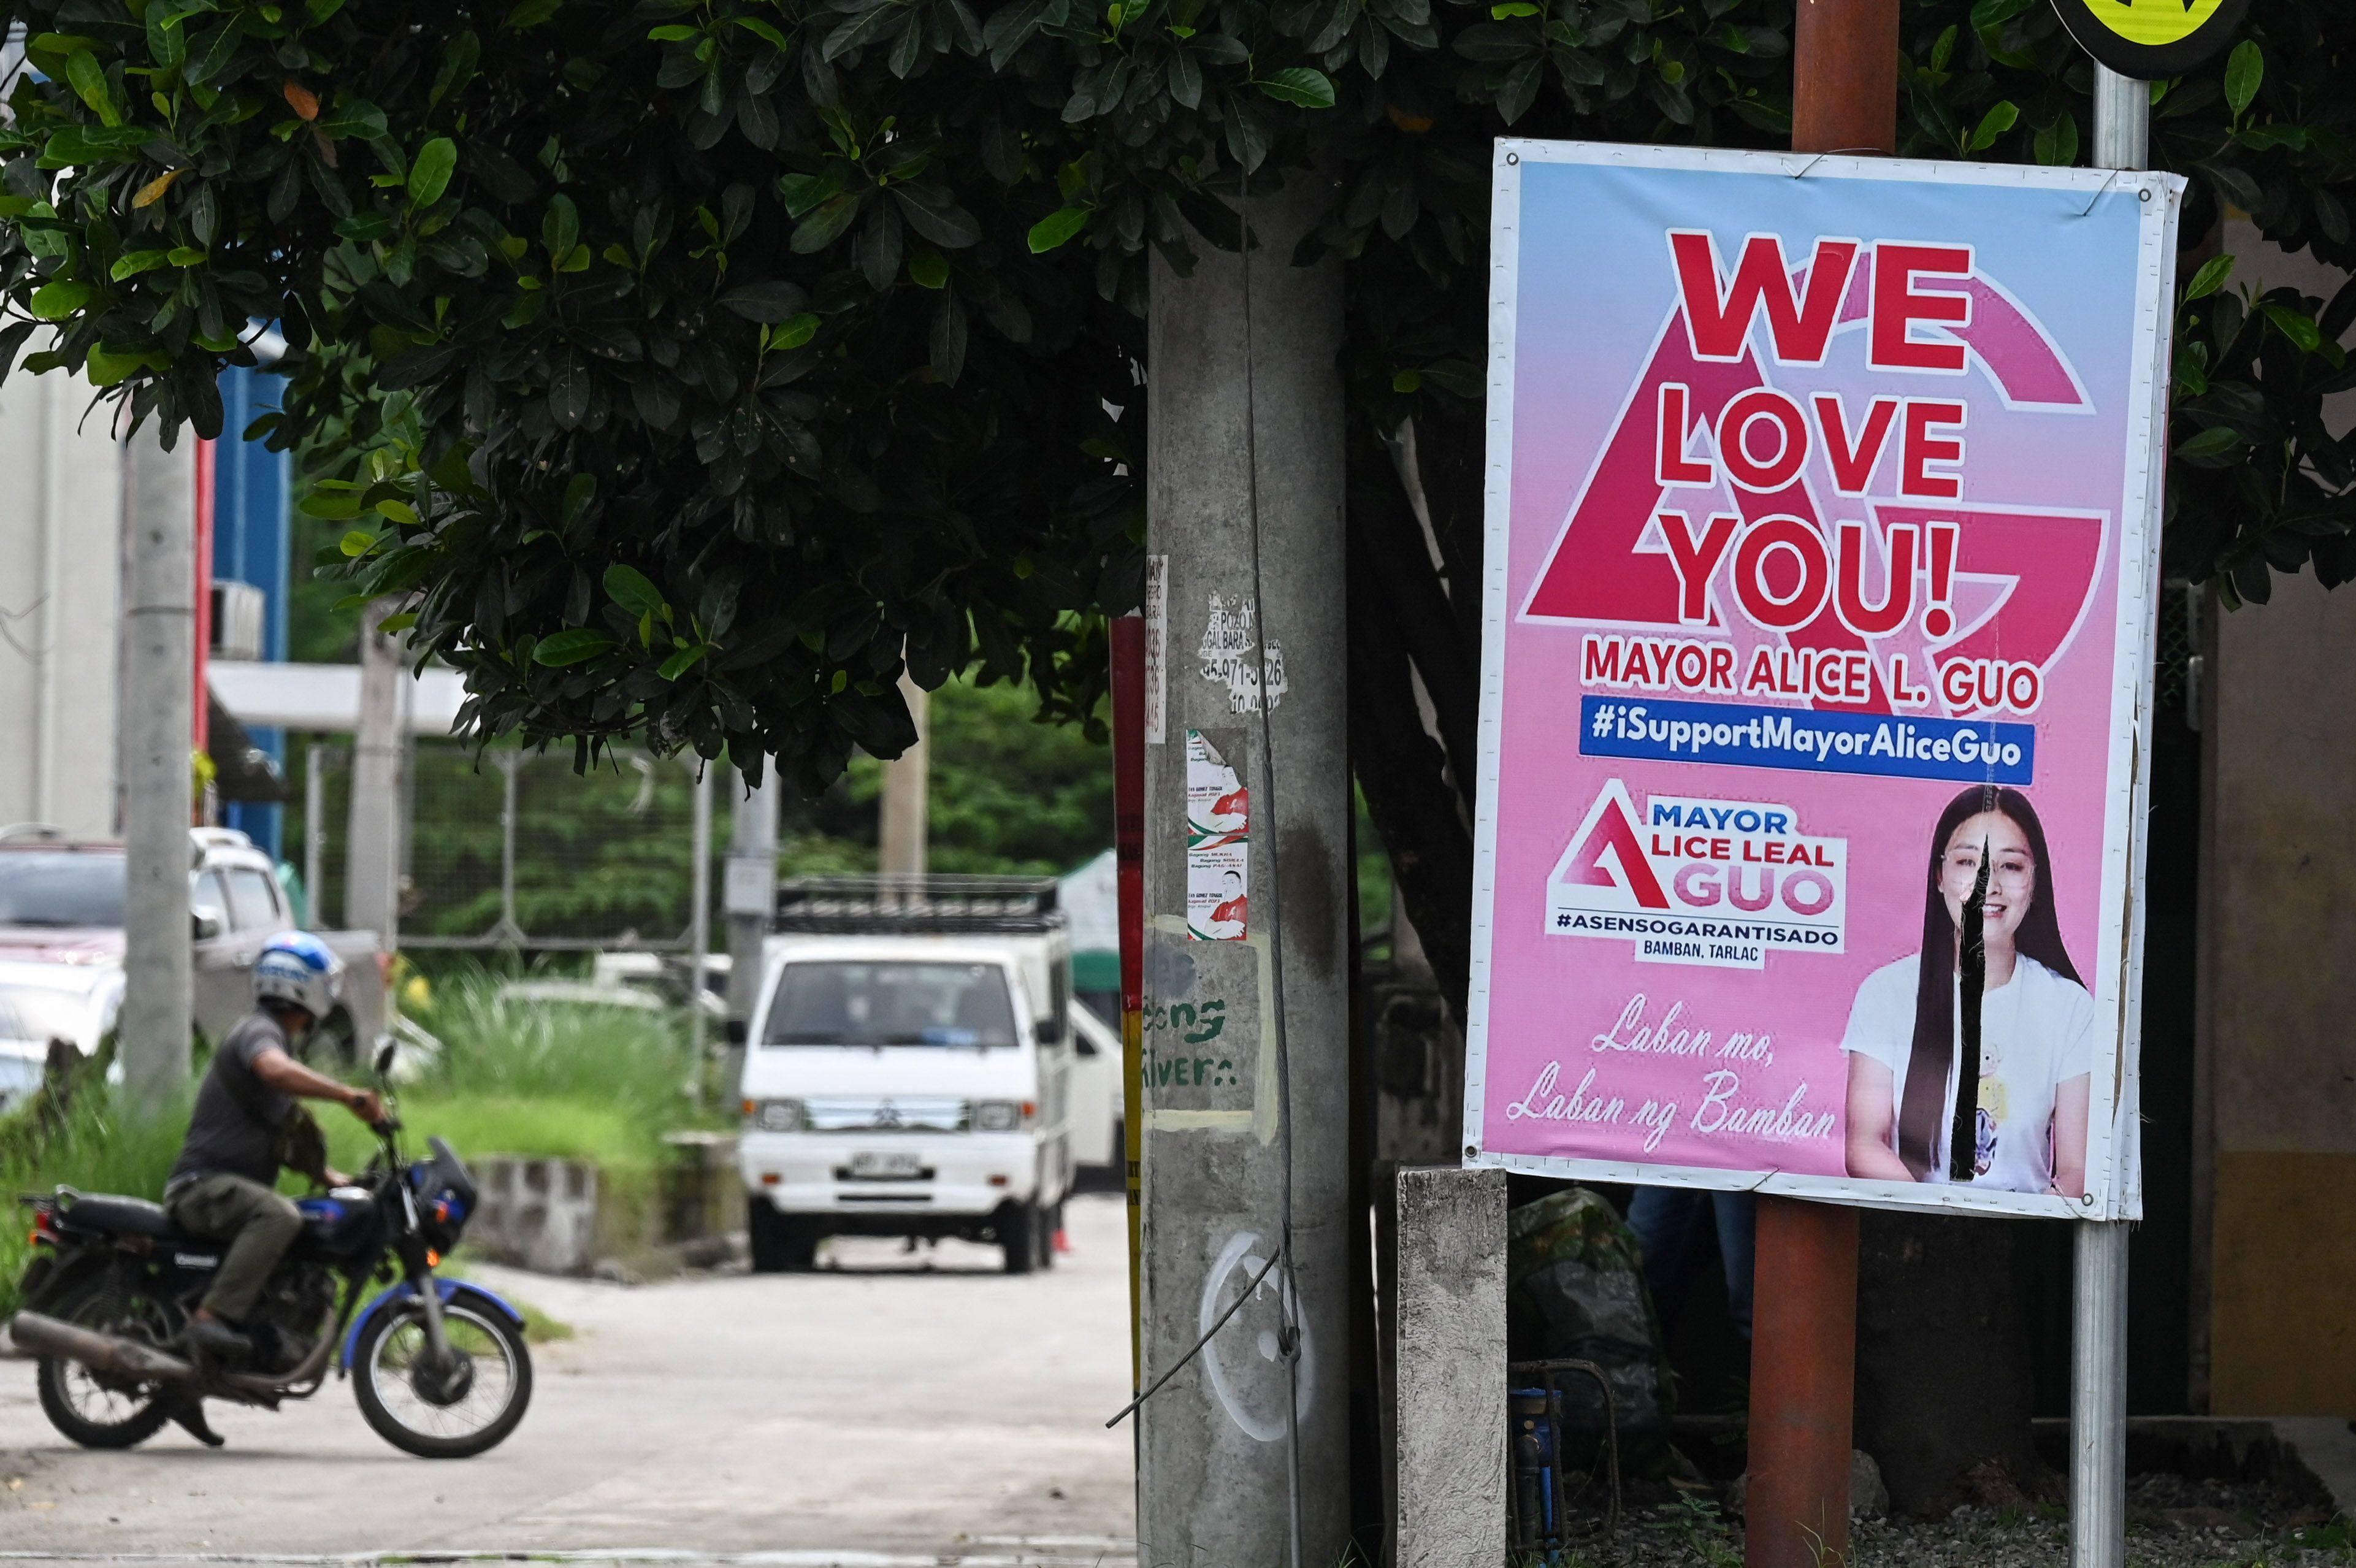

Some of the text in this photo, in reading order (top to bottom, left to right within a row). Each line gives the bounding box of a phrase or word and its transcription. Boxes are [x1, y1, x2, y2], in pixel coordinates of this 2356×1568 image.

[1669, 232, 1972, 370] WE
[1658, 386, 1964, 499] LOVE
[1654, 512, 1960, 638] YOU!
[1584, 640, 2039, 708] MAYOR ALICE L. GUO
[1592, 703, 2022, 767] #iSupportMayorAliceGuo
[1653, 804, 1789, 835] MAYOR
[1743, 840, 1835, 867] LEAL
[1673, 862, 1835, 916] GUO
[1556, 913, 1839, 946] #ASENSOGARANTISADO
[1709, 943, 1759, 961] TARLAC
[1592, 993, 1775, 1068] Laban mo,
[1506, 1060, 1836, 1153] Laban ng Bamban
